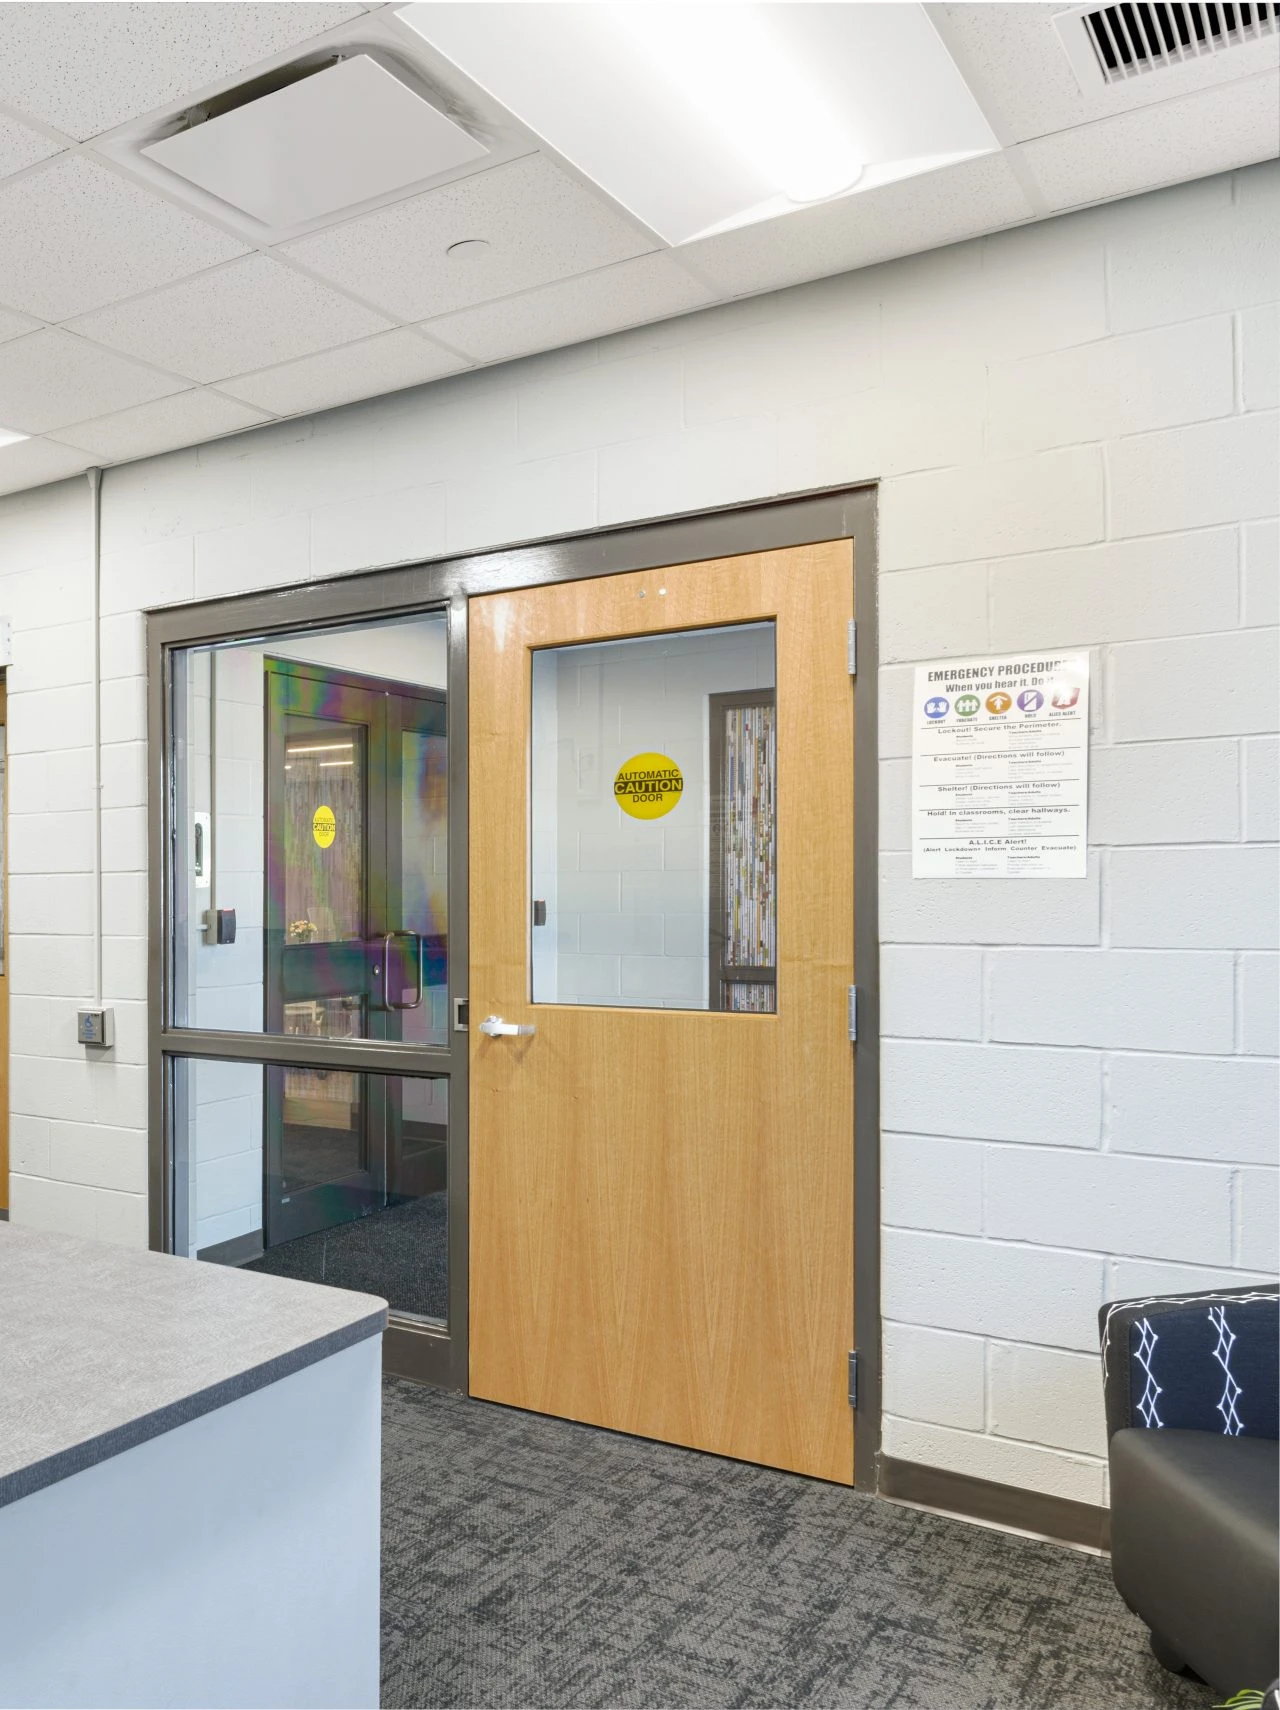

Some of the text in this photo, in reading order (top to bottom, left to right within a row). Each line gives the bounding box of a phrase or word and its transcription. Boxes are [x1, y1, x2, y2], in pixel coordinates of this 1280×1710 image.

[928, 660, 1068, 682] EMERGENCY PROCEDU
[946, 684, 972, 692] When
[976, 682, 992, 691] you
[994, 680, 1018, 688] hear
[1020, 678, 1029, 686] it.
[1032, 678, 1044, 686] Do
[618, 768, 680, 780] AUTOMATIC
[615, 780, 682, 794] CAUTION
[632, 794, 663, 802] DOOR
